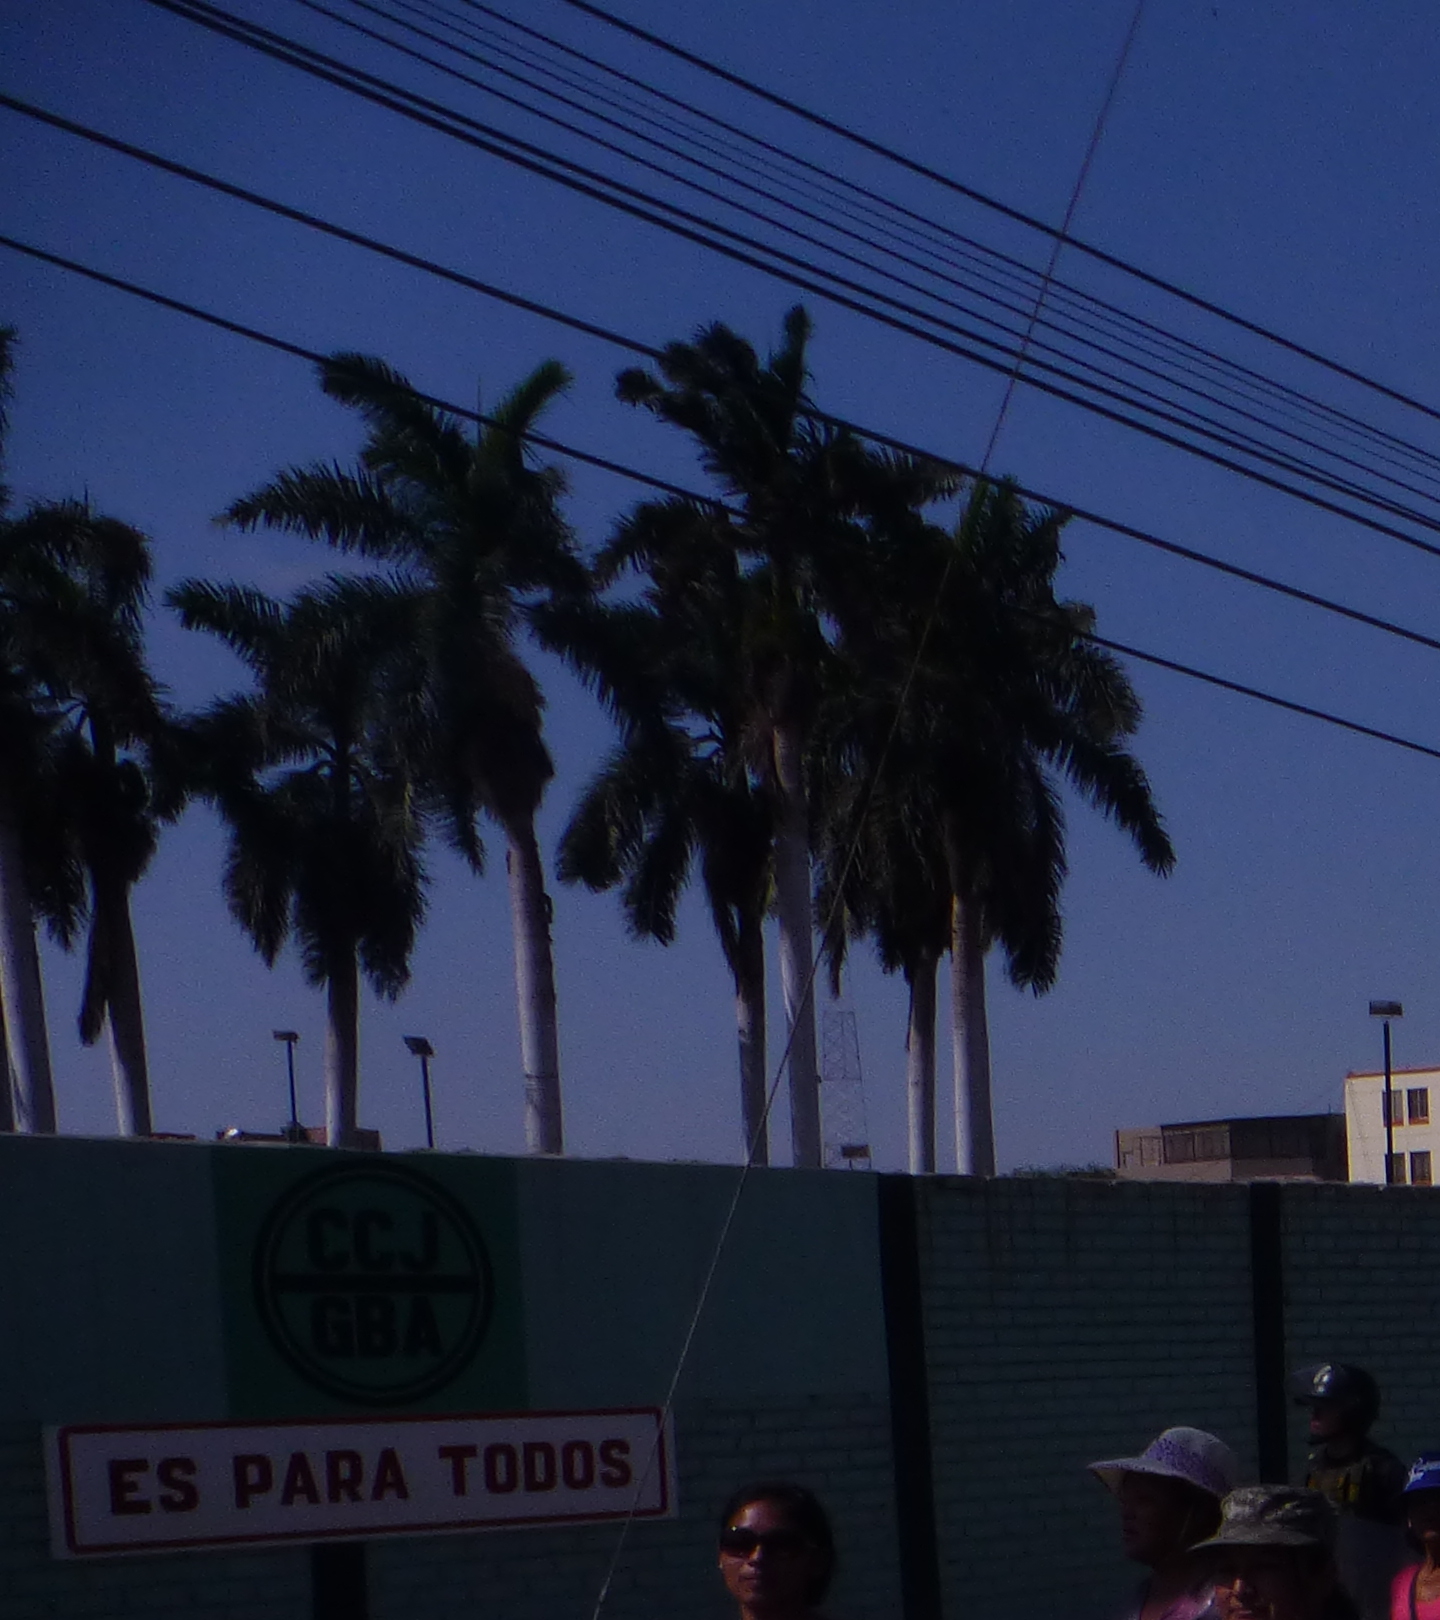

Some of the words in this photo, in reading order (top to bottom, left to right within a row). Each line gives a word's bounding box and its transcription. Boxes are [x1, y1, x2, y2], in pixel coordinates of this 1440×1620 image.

[306, 1208, 439, 1275] CCJ
[310, 1295, 443, 1358] GBA
[108, 1458, 199, 1515] ES
[233, 1447, 408, 1509] PARA
[439, 1439, 632, 1496] TODOS
